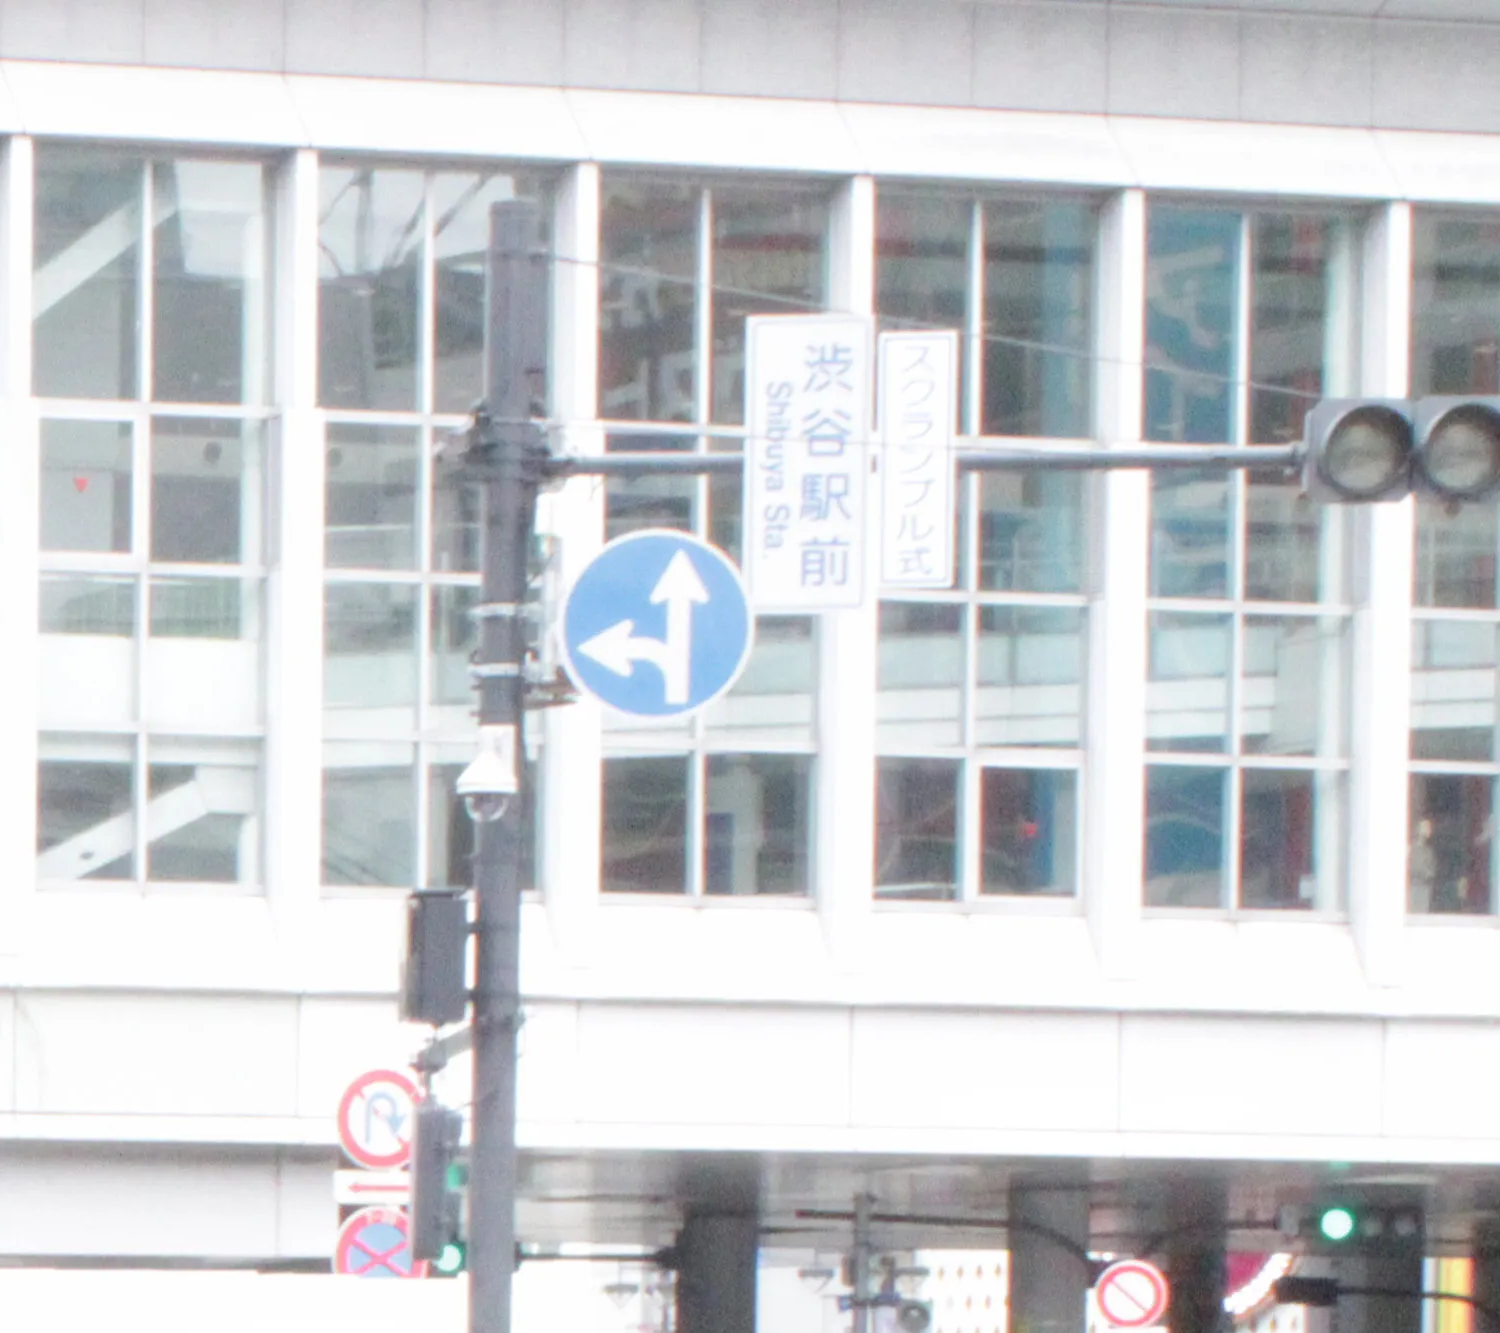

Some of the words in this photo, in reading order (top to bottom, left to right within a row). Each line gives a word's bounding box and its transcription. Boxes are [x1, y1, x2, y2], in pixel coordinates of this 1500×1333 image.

[759, 380, 794, 493] Shibuya
[800, 342, 853, 588] 渋谷駅前
